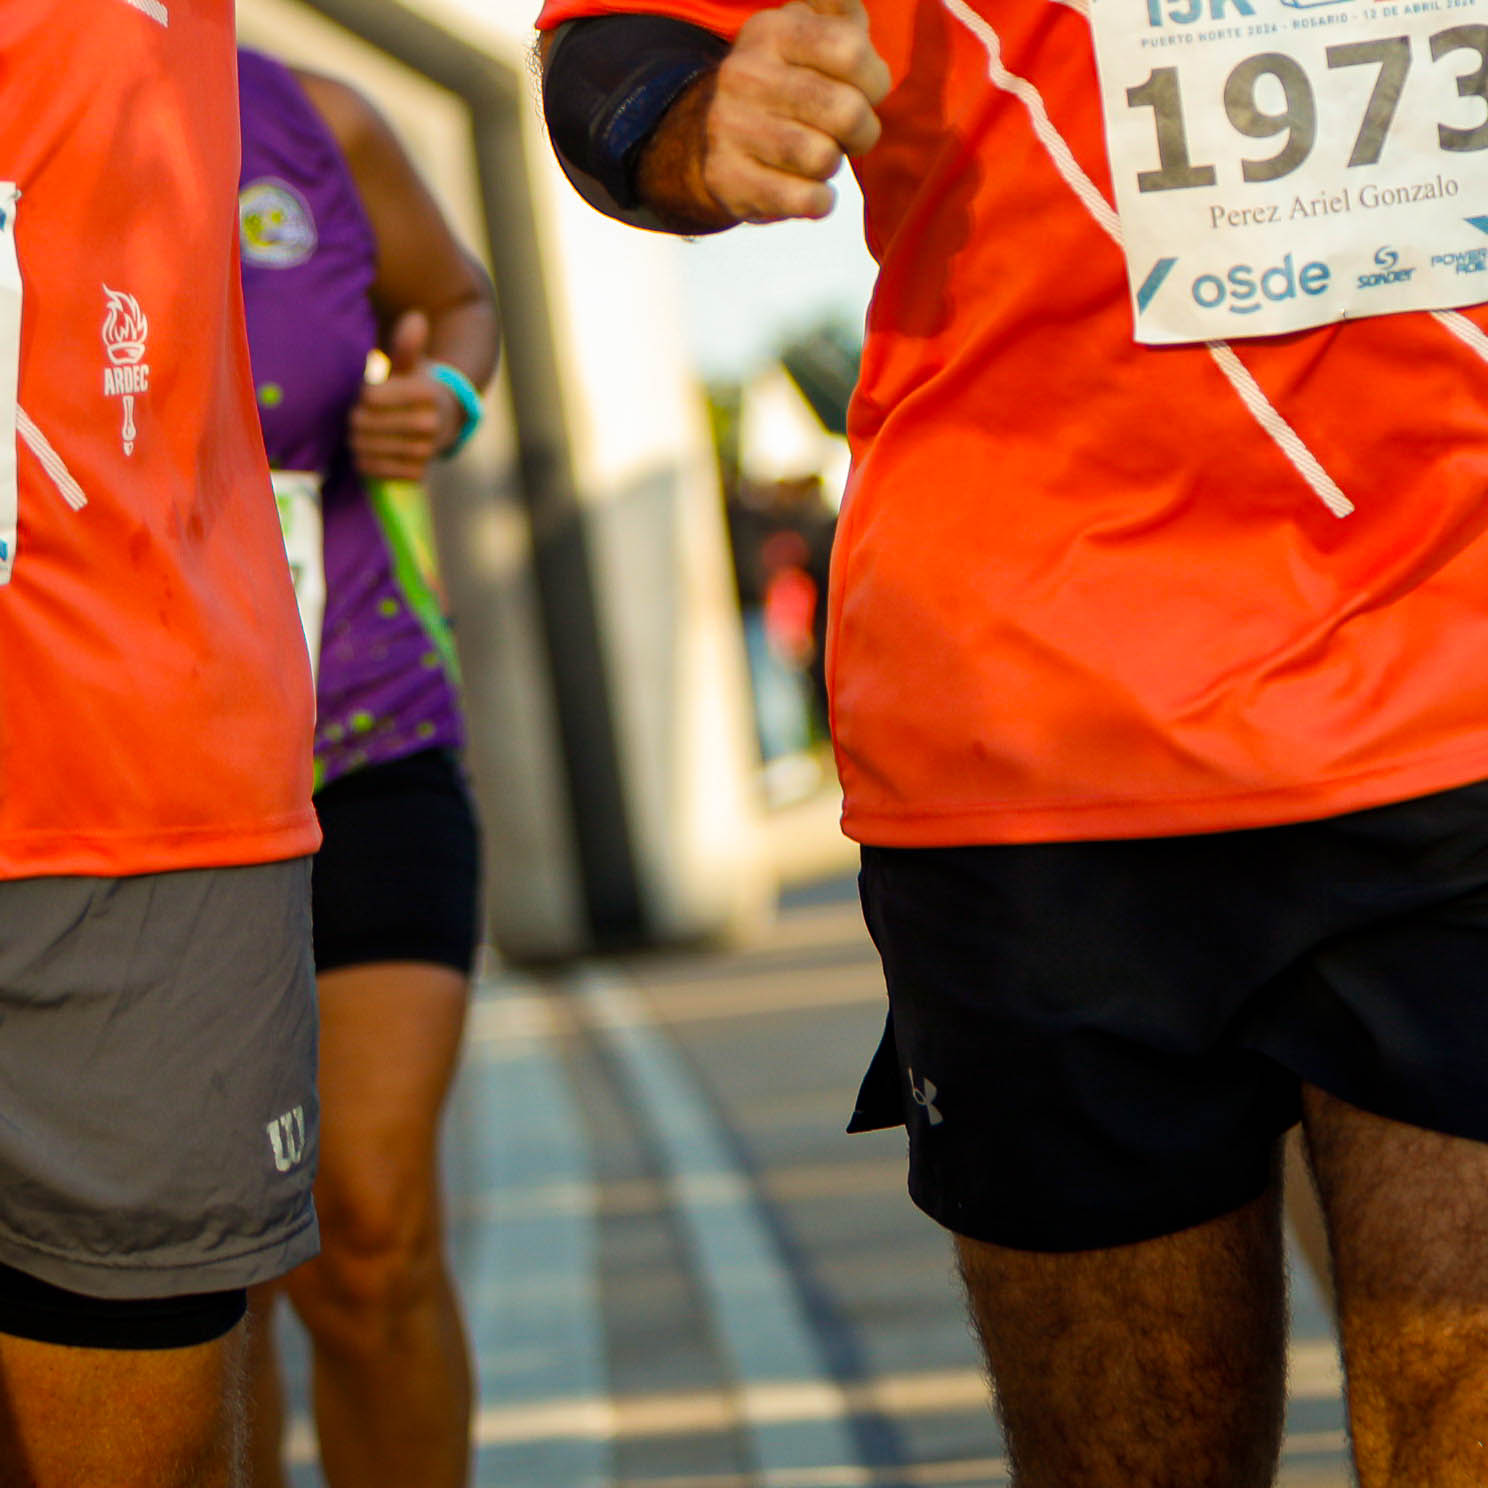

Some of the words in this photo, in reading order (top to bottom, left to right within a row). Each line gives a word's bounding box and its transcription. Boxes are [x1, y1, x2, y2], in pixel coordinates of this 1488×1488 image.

[1141, 33, 1193, 48] PUERTO
[1199, 27, 1241, 42] NORTE
[1292, 13, 1348, 30] ROSARIO
[1383, 6, 1398, 17] DE
[1404, 2, 1440, 15] ABRIL
[1209, 202, 1282, 230] Perez
[1289, 188, 1351, 221] Ariel
[1359, 175, 1459, 210] Gonzalo
[1192, 252, 1331, 308] osde
[104, 364, 149, 396] ARDEC
